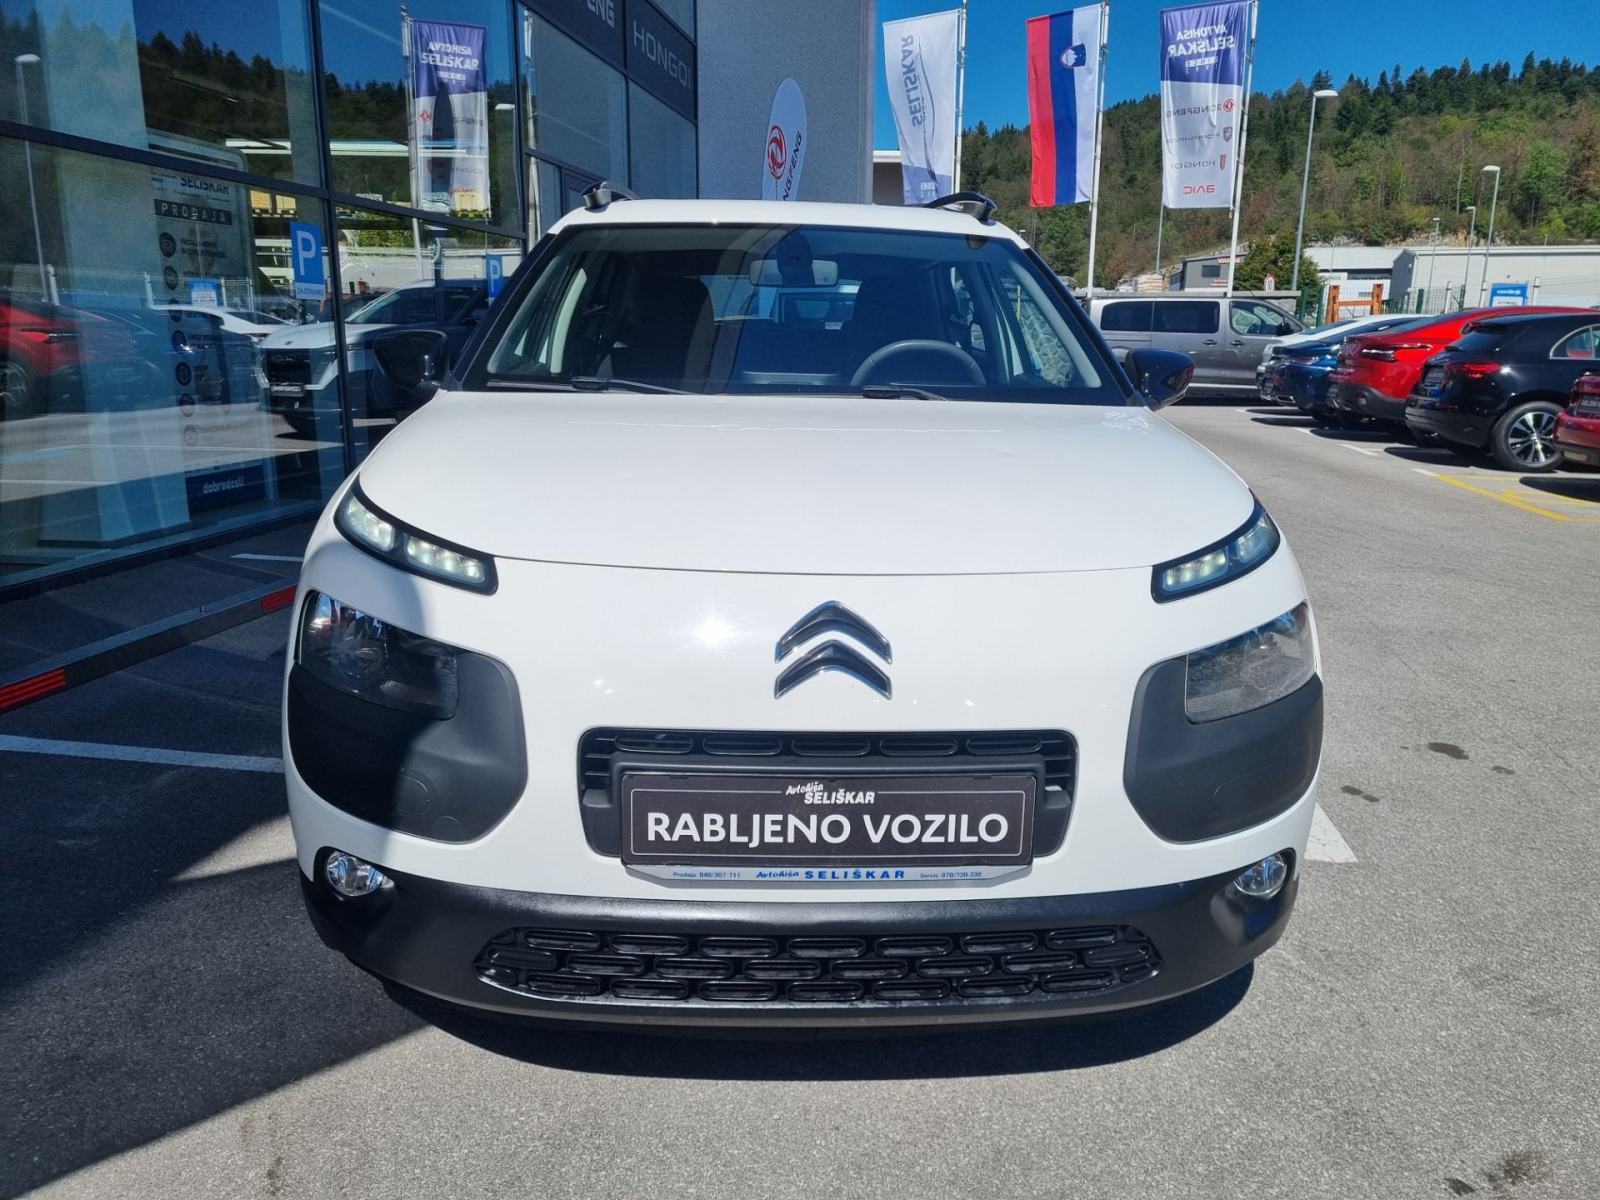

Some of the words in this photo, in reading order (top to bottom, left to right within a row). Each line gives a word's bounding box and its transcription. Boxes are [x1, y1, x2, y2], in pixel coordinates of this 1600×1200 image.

[296, 230, 317, 276] P
[489, 259, 501, 293] P
[804, 788, 875, 805] SELIŠKAR
[647, 812, 851, 848] RABLJENO
[862, 813, 1009, 844] VOZILO
[804, 869, 905, 879] SELIŠKAR
